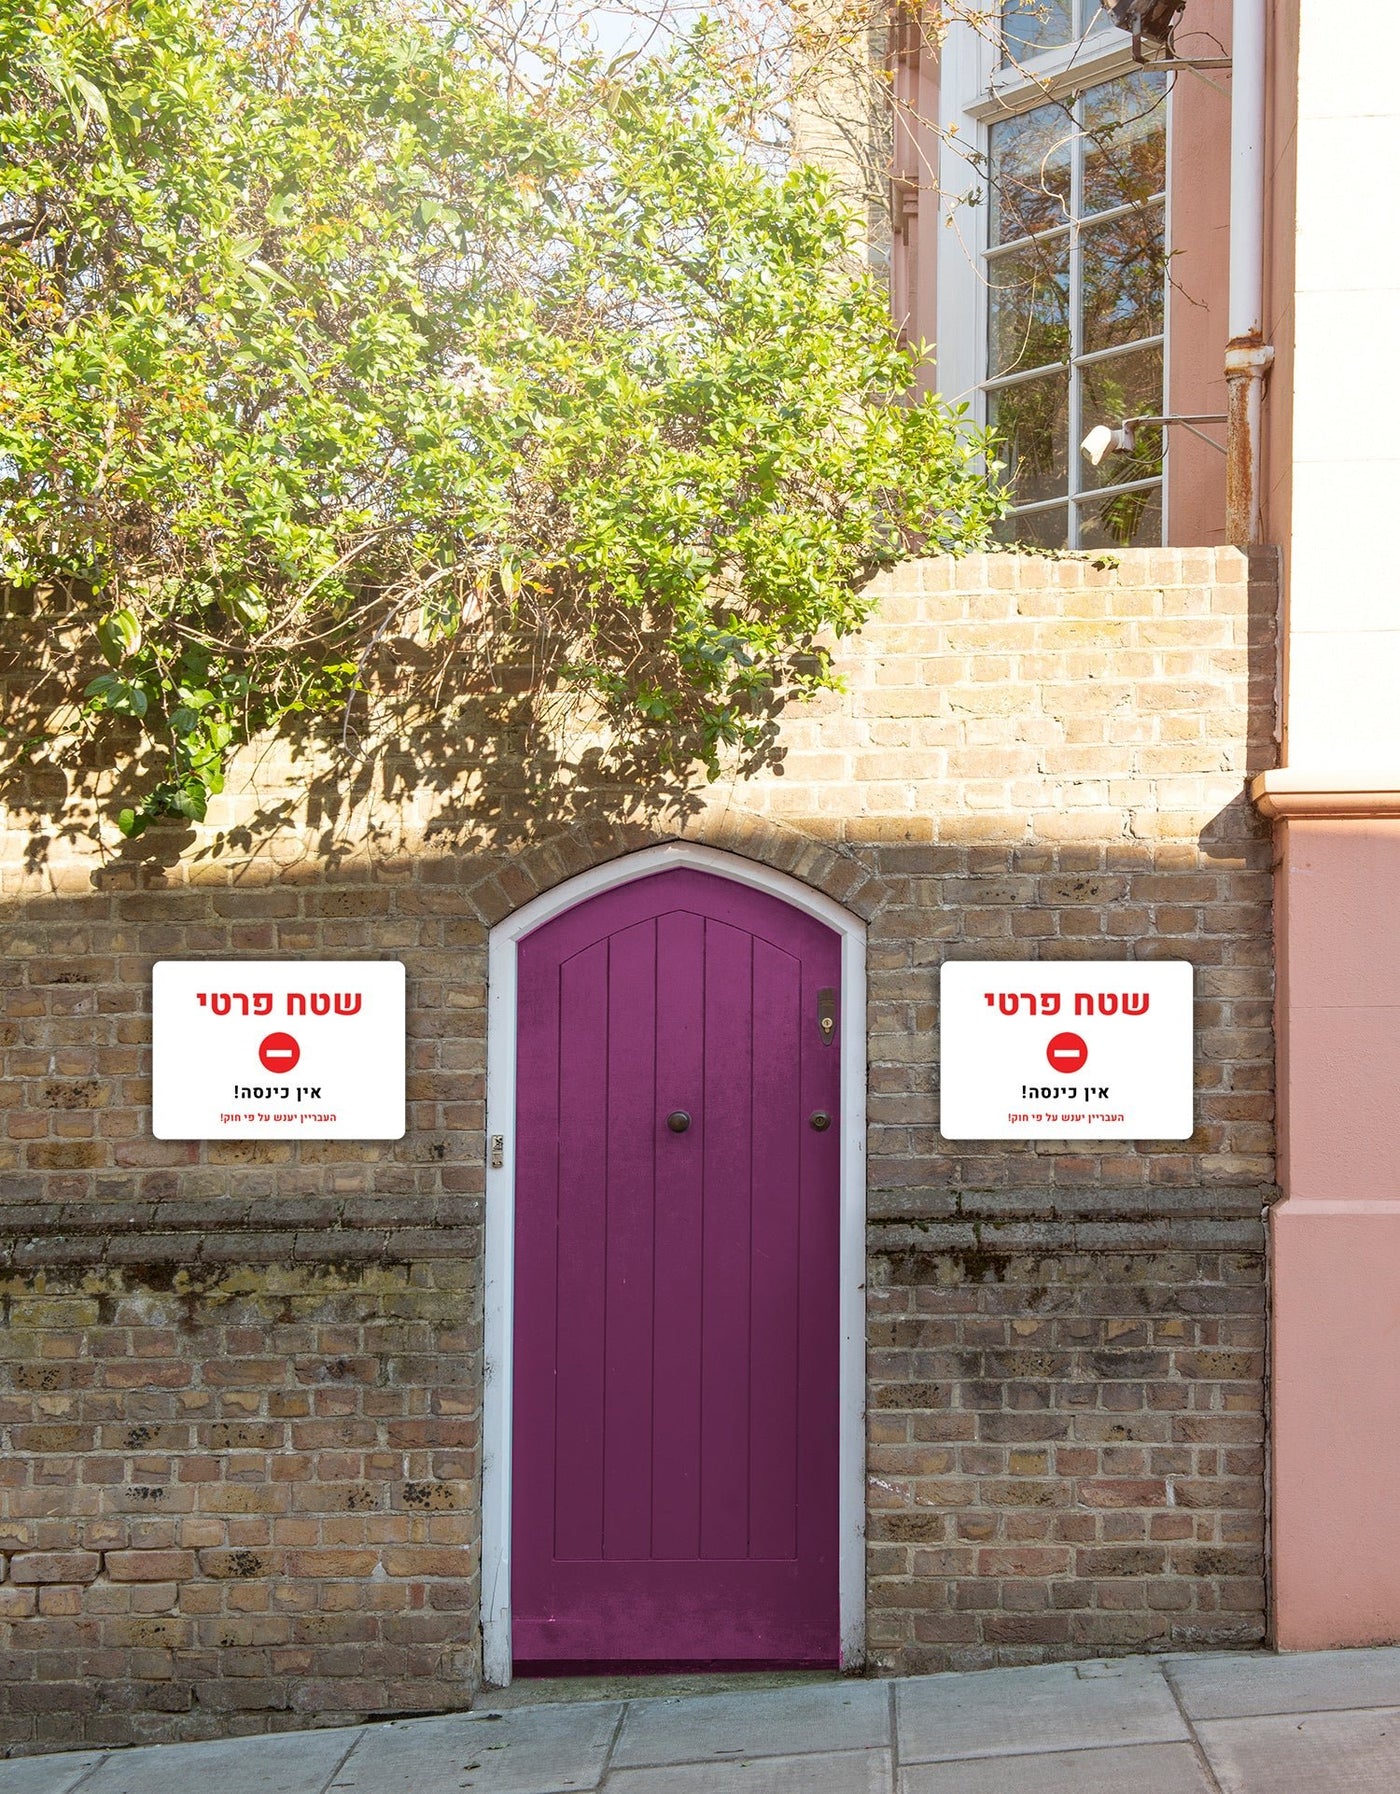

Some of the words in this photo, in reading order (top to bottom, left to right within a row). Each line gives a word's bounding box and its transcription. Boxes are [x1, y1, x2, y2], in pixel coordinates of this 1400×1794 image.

[196, 992, 273, 1016] פרטי
[286, 992, 362, 1016] שטח
[984, 992, 1061, 1016] פרטי
[1074, 992, 1150, 1016] שטח
[234, 1085, 290, 1099] כינסה!
[296, 1086, 322, 1102] אין
[1022, 1085, 1078, 1099] כינסה!
[1084, 1086, 1110, 1102] אין
[220, 1112, 241, 1124] חוק!
[243, 1113, 255, 1122] פי
[257, 1112, 271, 1122] על
[273, 1113, 298, 1122] יענש
[300, 1113, 337, 1124] העבריין
[1008, 1112, 1029, 1124] חוק!
[1031, 1113, 1043, 1122] פי
[1045, 1112, 1059, 1122] על
[1061, 1113, 1086, 1122] יענש
[1088, 1113, 1125, 1124] העבריין
